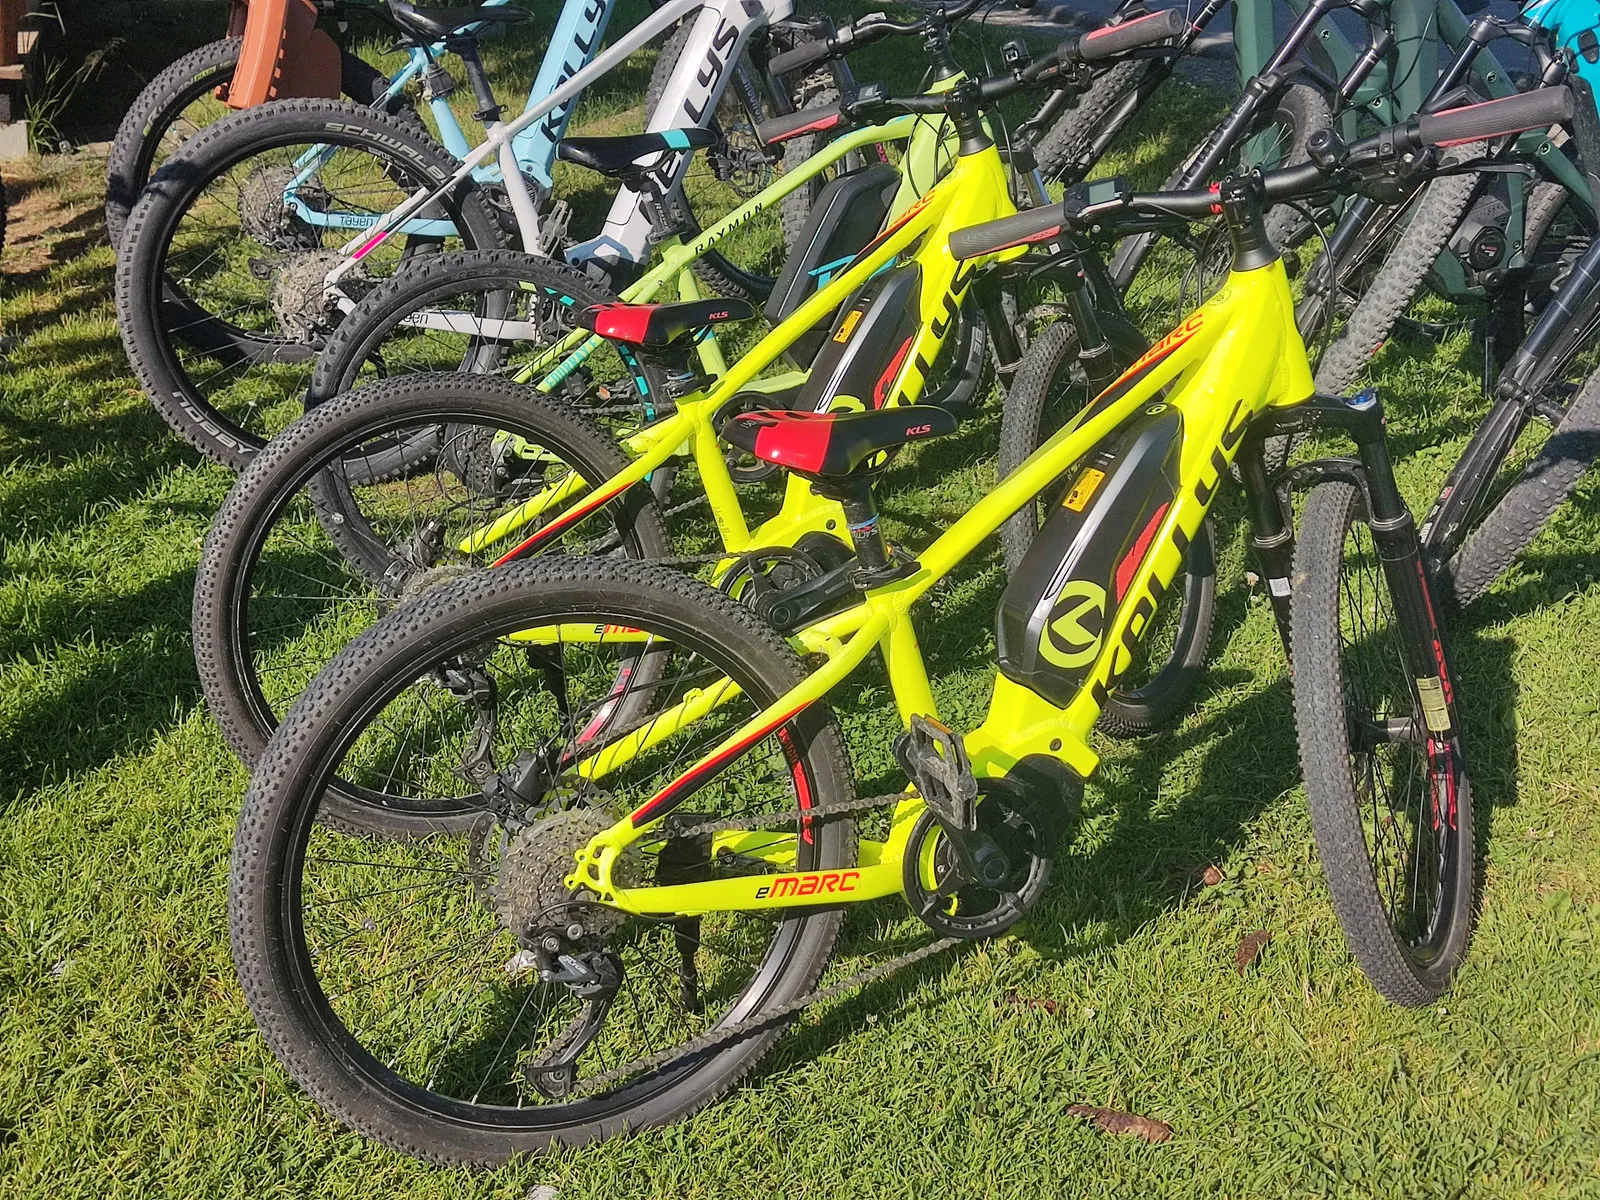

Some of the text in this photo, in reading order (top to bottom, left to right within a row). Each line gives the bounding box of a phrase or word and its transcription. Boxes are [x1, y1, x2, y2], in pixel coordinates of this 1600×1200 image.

[323, 122, 454, 190] SCHWALB
[694, 201, 763, 256] RAYMON
[708, 310, 729, 320] KLS
[905, 424, 932, 437] KLS
